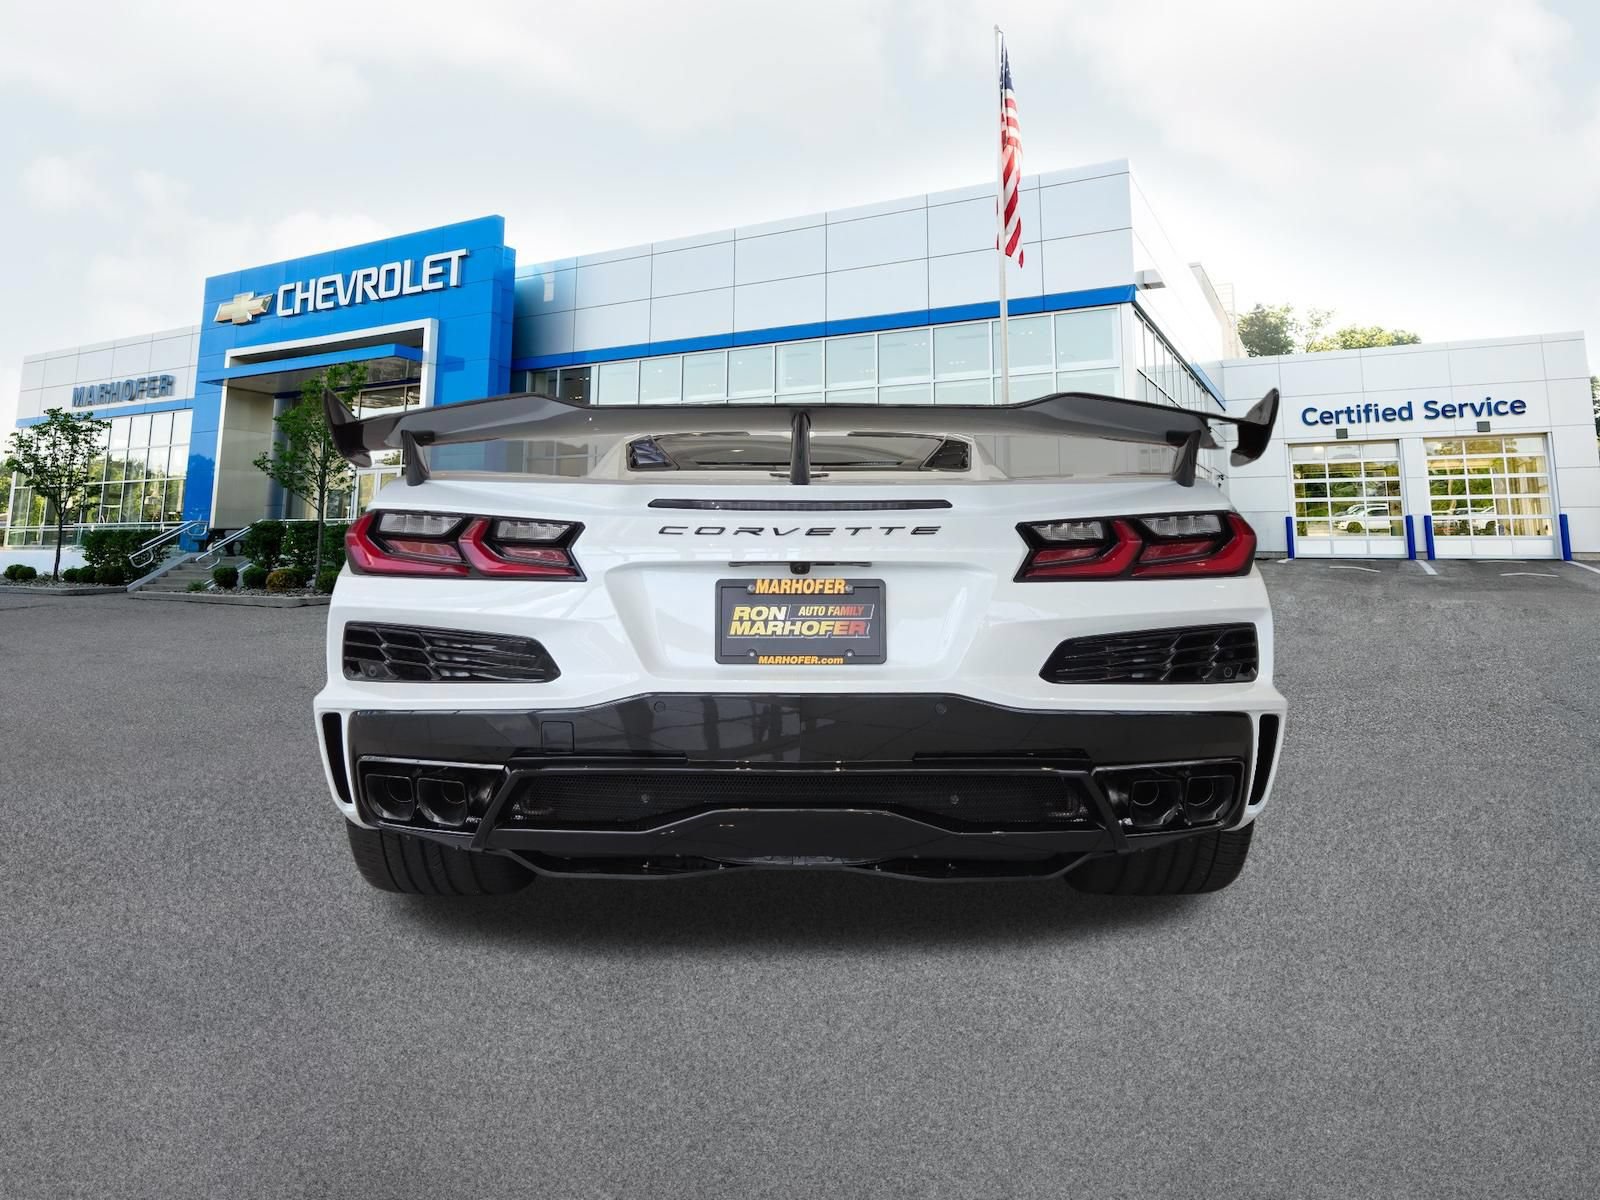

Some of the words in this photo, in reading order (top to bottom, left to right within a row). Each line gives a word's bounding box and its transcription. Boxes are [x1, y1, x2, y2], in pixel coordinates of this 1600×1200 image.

[276, 248, 470, 317] CHEVROLET
[72, 374, 175, 407] MARHOFER
[1301, 401, 1414, 426] Certified
[1423, 396, 1528, 421] Service
[658, 525, 942, 537] CORVETTE
[754, 578, 846, 594] MARHOFER
[732, 606, 787, 621] RON
[799, 605, 825, 617] AUTO
[827, 605, 865, 617] FAMILY
[729, 621, 866, 636] MARHOFER
[757, 655, 844, 665] MARHOFER.com
